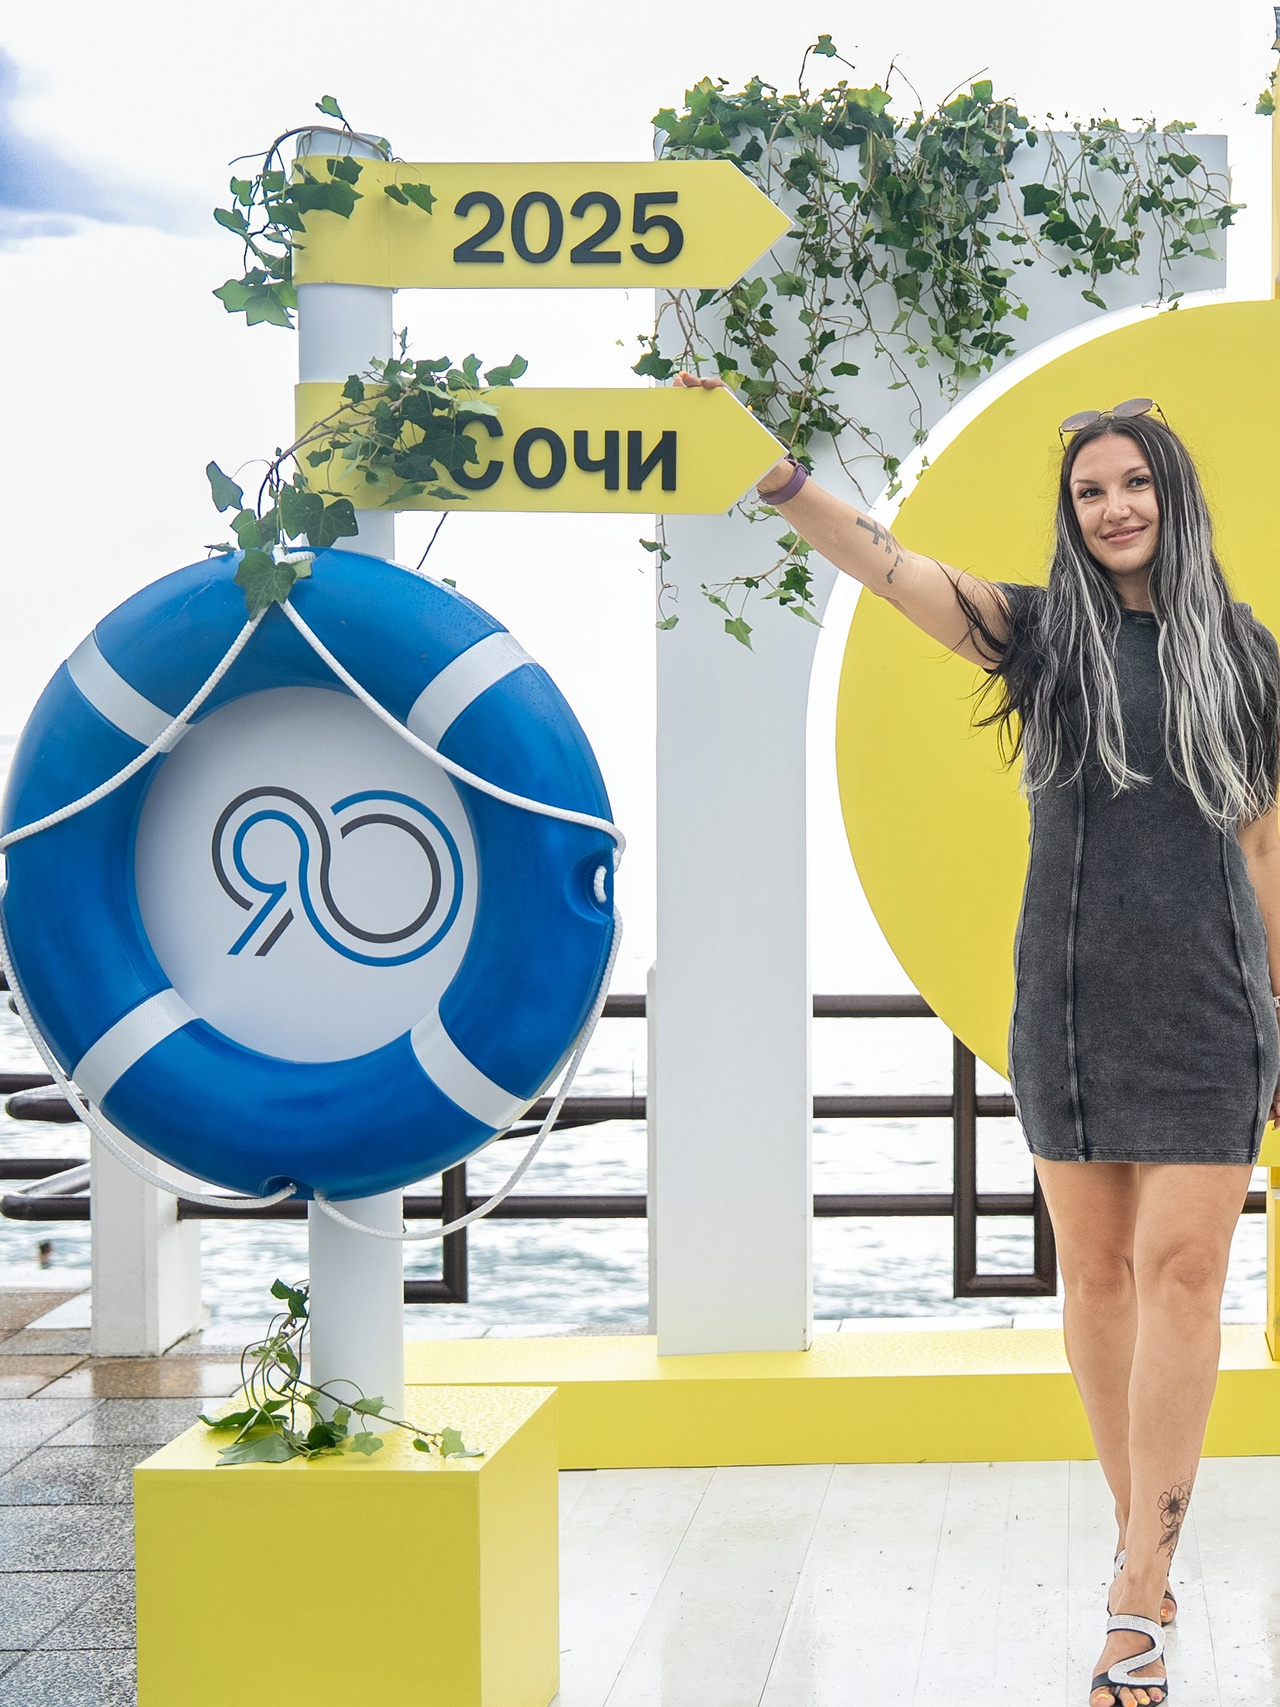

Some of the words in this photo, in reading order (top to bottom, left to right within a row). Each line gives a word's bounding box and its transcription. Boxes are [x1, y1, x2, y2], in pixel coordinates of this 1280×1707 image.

[453, 191, 684, 264] 2025
[448, 413, 677, 490] Сочи
[211, 785, 464, 967] 90
